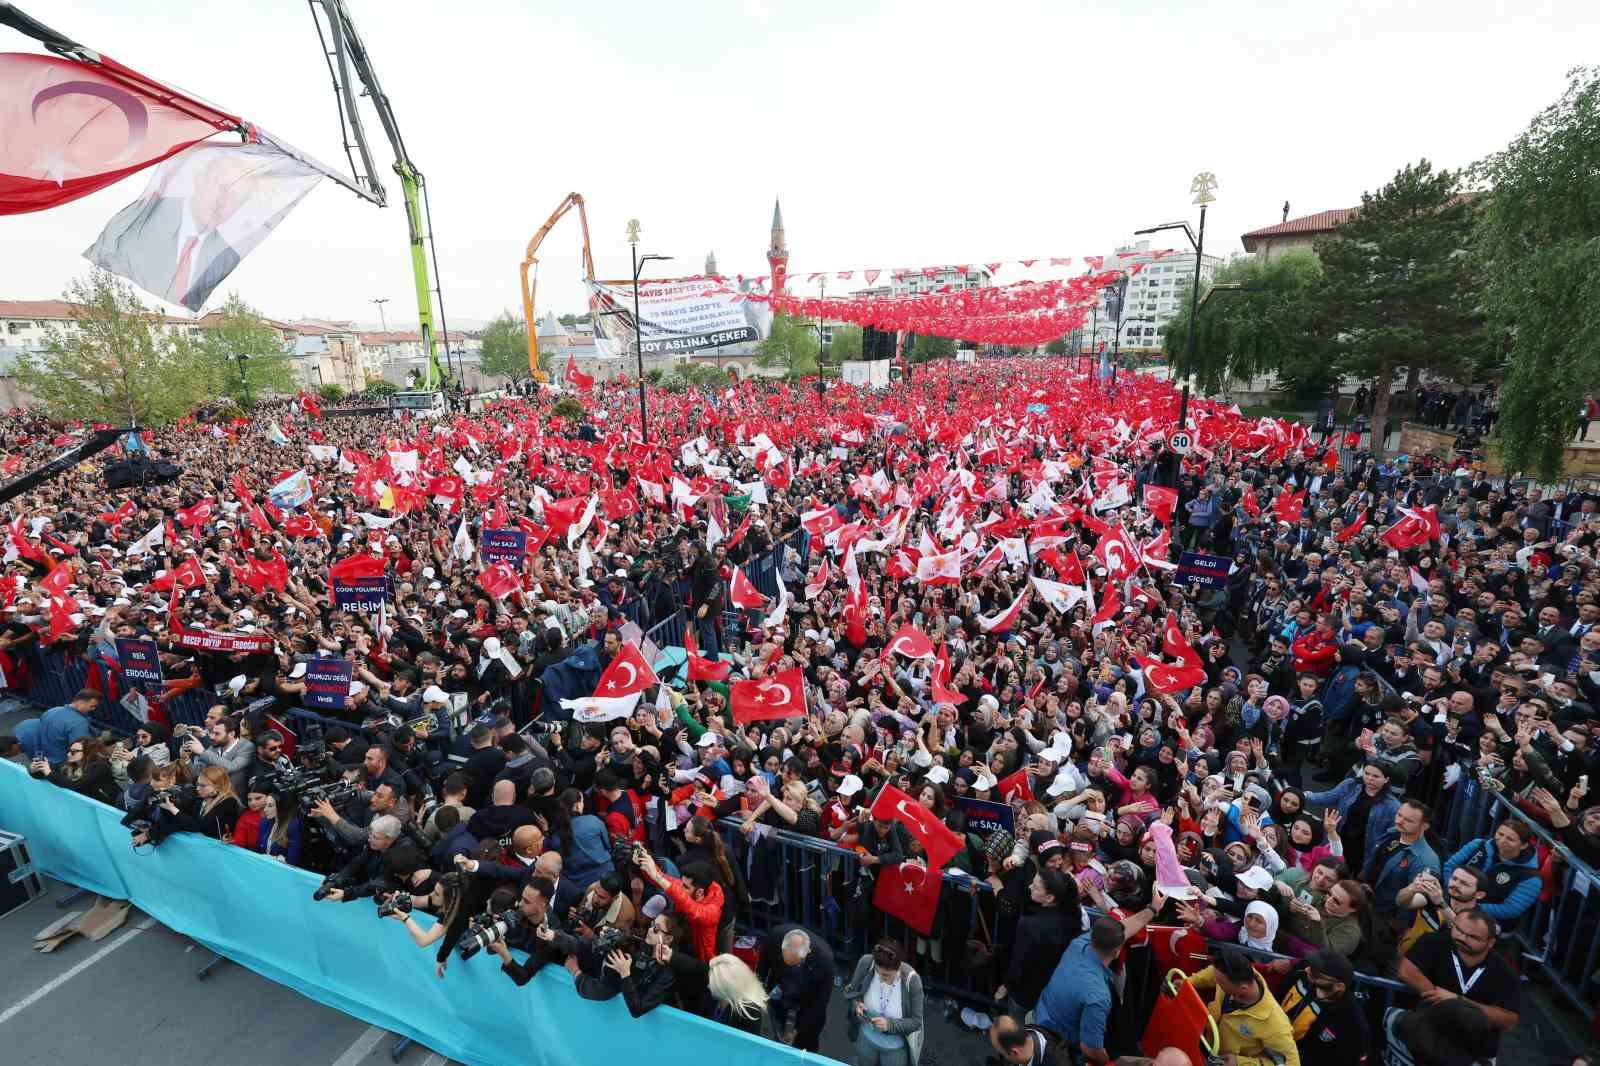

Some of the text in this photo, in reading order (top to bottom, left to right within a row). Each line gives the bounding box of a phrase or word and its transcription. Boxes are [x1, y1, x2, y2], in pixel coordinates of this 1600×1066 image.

[665, 336, 709, 350] ASLINA
[711, 329, 748, 345] ÇEKER
[1173, 436, 1188, 448] 50
[182, 634, 202, 646] RECEP
[125, 668, 160, 680] ERDOĞAN
[979, 819, 1003, 831] SAZA
